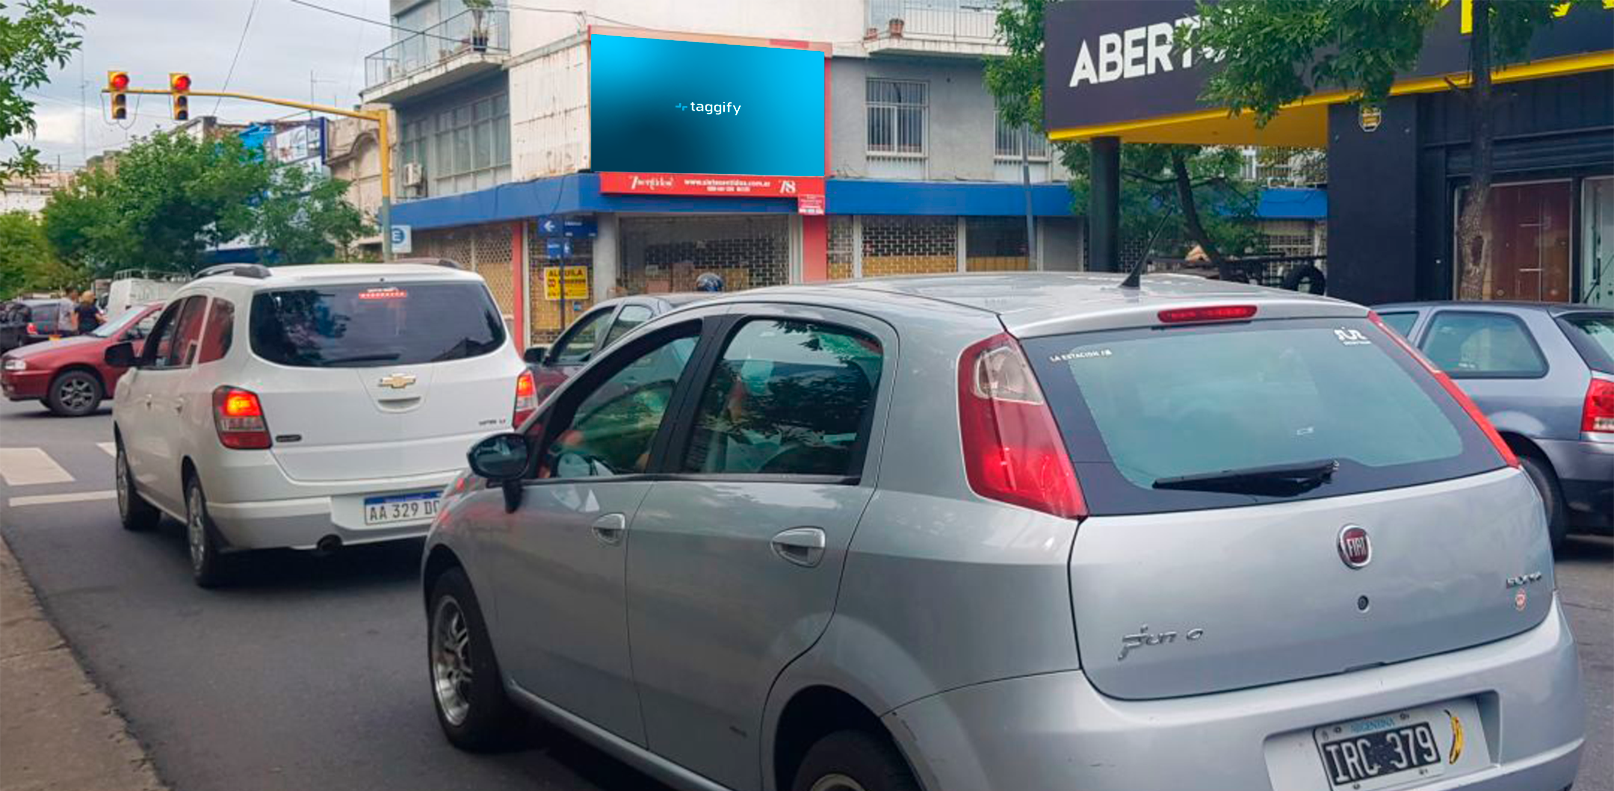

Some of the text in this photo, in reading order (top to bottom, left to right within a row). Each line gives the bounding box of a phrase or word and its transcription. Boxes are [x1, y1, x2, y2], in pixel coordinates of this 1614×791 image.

[690, 101, 741, 116] taggify
[370, 505, 387, 520] AA
[392, 501, 419, 518] 329
[1345, 537, 1367, 557] FIAT
[1326, 726, 1438, 783] IRC 379
